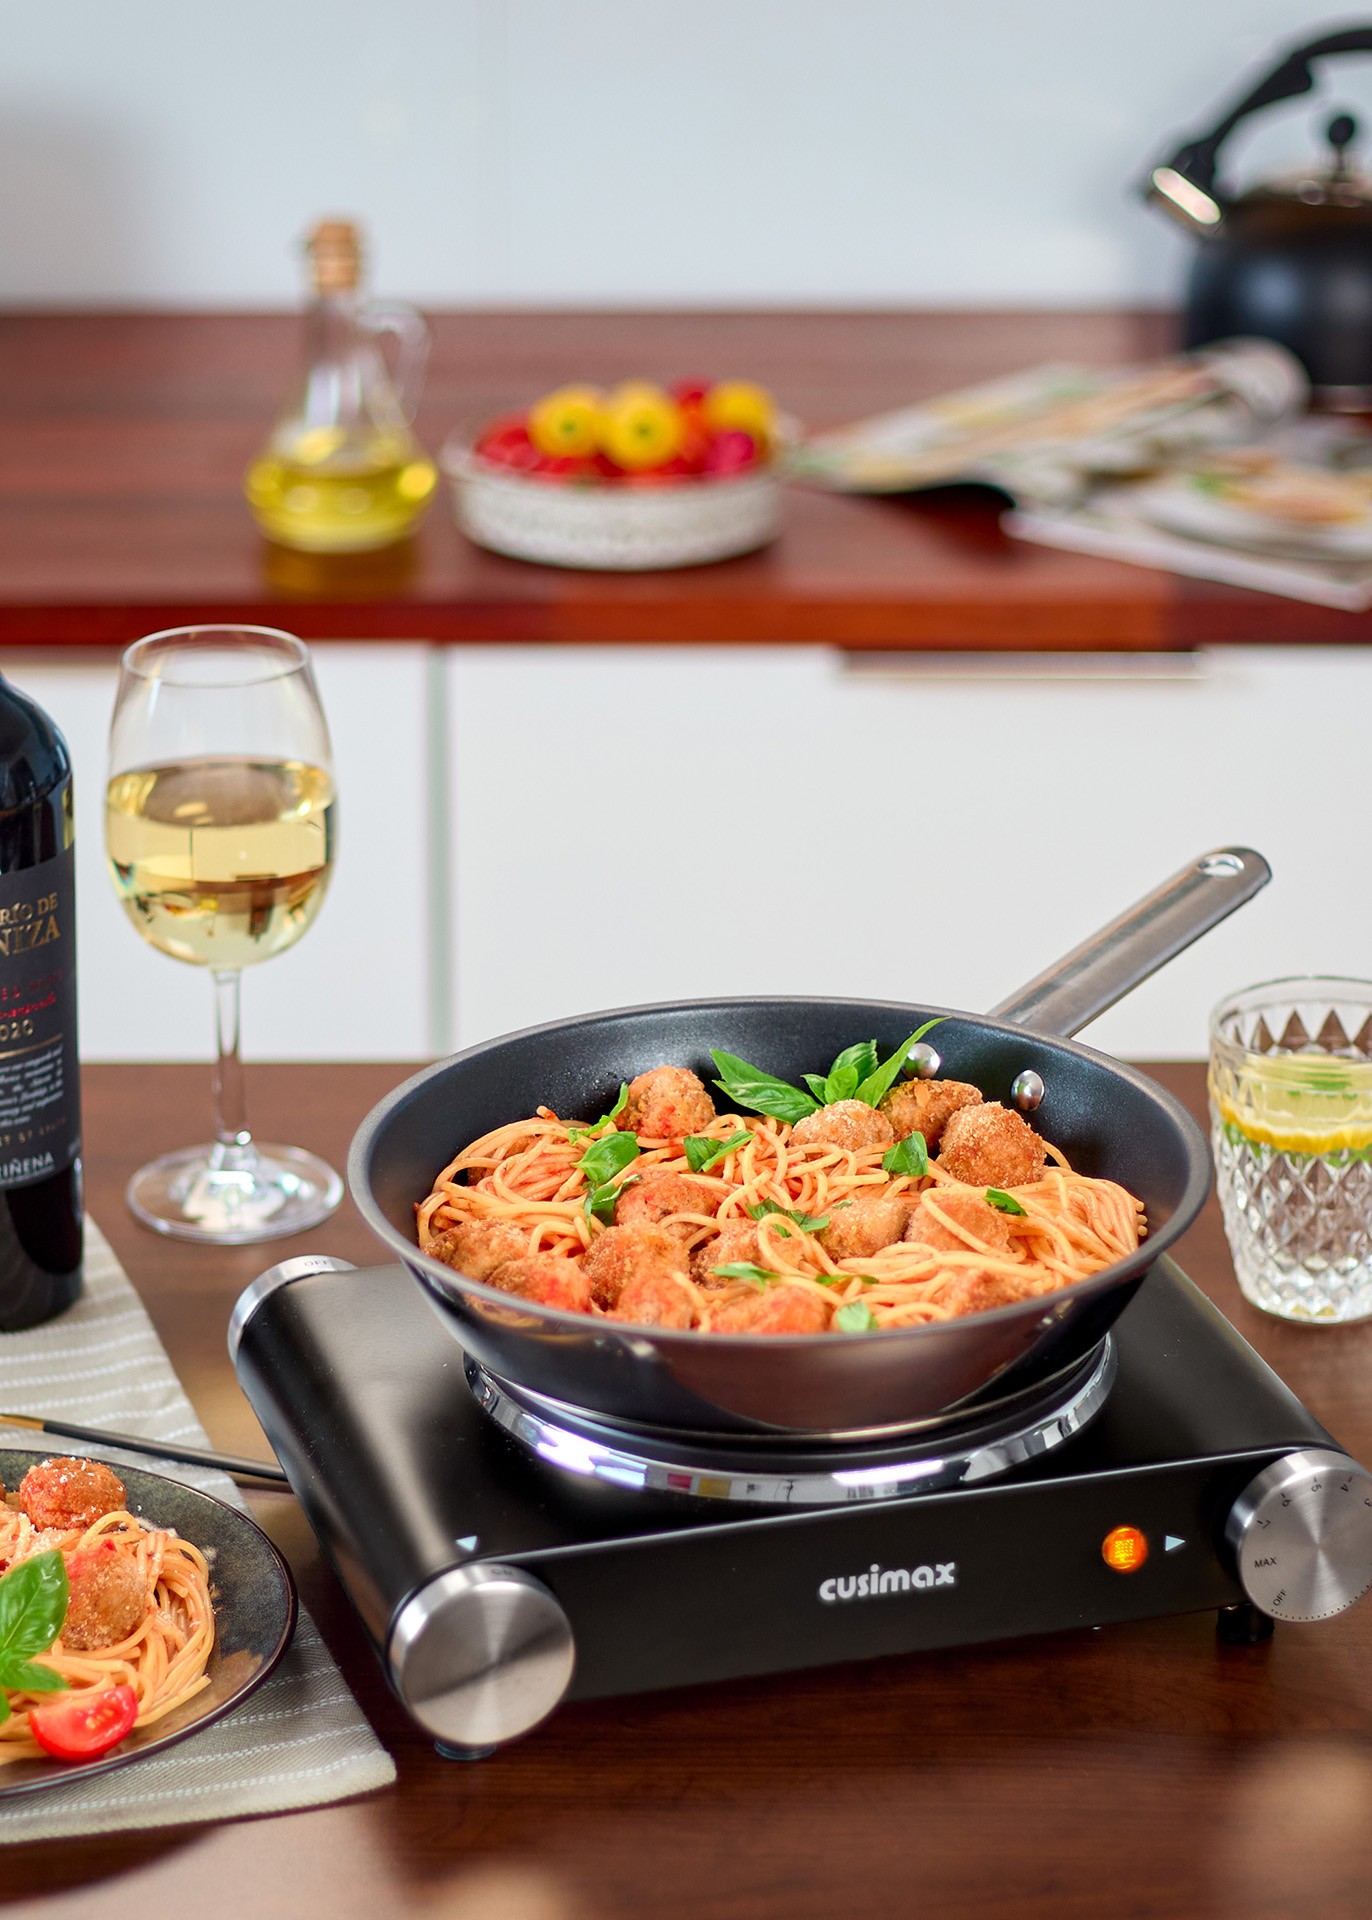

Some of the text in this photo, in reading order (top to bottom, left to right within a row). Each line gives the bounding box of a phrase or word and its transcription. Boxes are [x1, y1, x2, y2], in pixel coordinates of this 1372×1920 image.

[37, 891, 58, 916] DE
[0, 1151, 54, 1180] IÑENA
[1311, 1484, 1322, 1492] 5
[1341, 1484, 1349, 1492] 4
[1282, 1499, 1292, 1508] 6
[1364, 1498, 1372, 1507] 3
[1262, 1519, 1271, 1530] 7
[1254, 1557, 1277, 1569] MAX
[819, 1562, 955, 1601] cusimax
[1273, 1589, 1287, 1606] OFF
